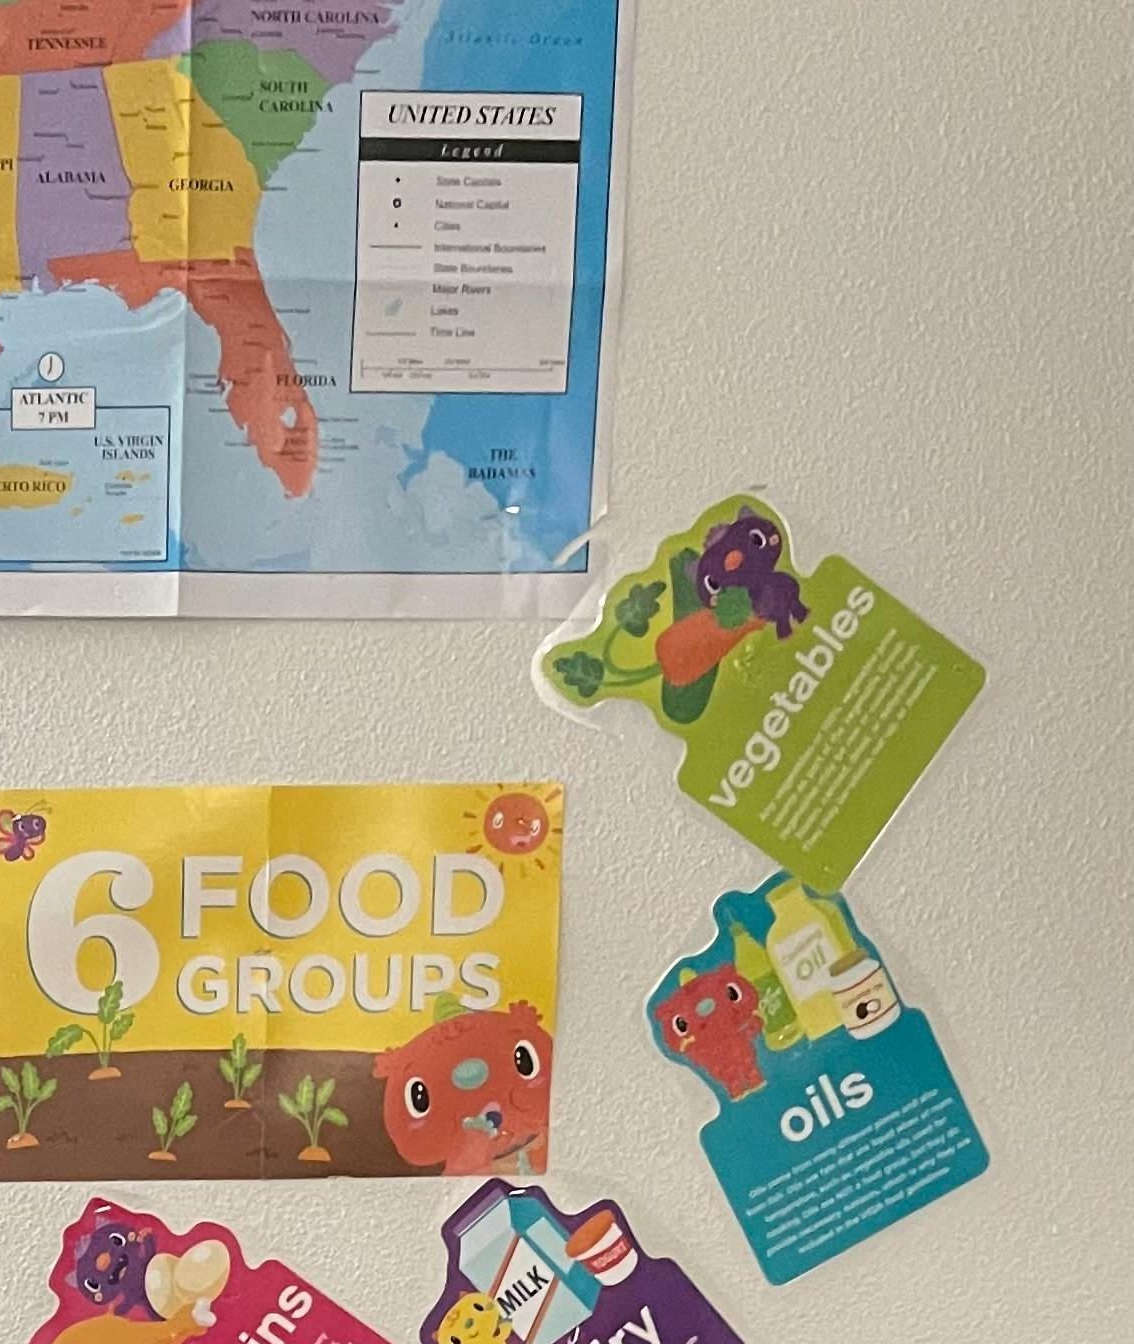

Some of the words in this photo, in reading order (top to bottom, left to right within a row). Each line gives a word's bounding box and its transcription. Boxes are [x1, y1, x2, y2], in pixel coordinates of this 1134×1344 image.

[251, 10, 301, 23] NORTH
[305, 10, 380, 24] CAROLINA
[28, 36, 108, 51] TENNESSEE
[259, 81, 308, 94] SOUTH
[259, 100, 334, 113] CAROLINA
[388, 104, 472, 125] UNITED
[475, 105, 557, 126] STATES
[441, 143, 505, 159] Legend
[35, 171, 106, 185] ALABAMA
[168, 179, 234, 192] GEORGIA
[276, 375, 337, 388] FLORIDA
[20, 392, 89, 406] ATLANTIC
[39, 412, 46, 423] 7
[49, 411, 69, 424] PM
[118, 435, 165, 447] VIRGIN
[102, 449, 156, 460] ISLANDS
[489, 448, 518, 461] THE
[33, 481, 66, 492] RICO
[708, 585, 875, 808] vegetables
[26, 851, 159, 1015] 6
[181, 853, 505, 939] FOOD
[176, 953, 501, 1015] GROUPS
[780, 1071, 874, 1142] oils
[496, 1265, 549, 1316] MILK
